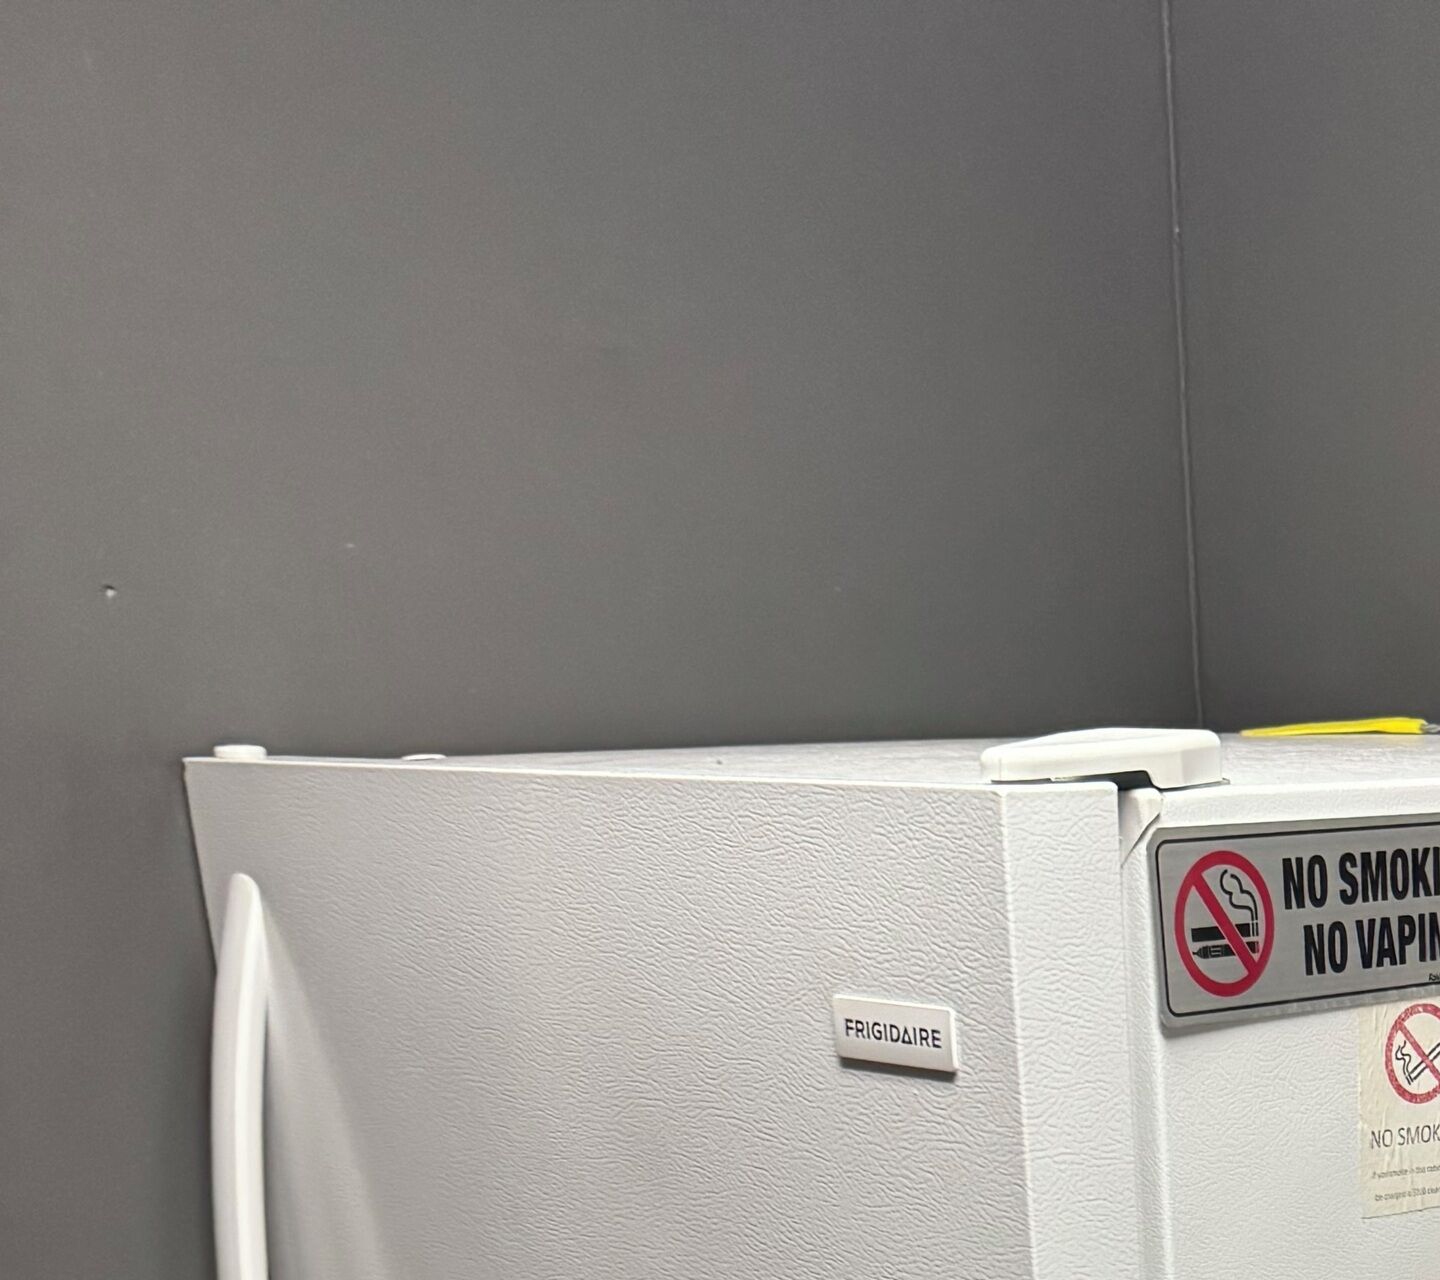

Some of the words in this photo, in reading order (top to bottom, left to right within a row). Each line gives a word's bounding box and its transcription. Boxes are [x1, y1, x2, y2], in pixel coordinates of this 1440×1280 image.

[1282, 854, 1328, 910] NO
[1303, 920, 1348, 976] NO
[844, 1018, 942, 1049] FRIGIDAIRE
[1370, 1129, 1393, 1149] NO
